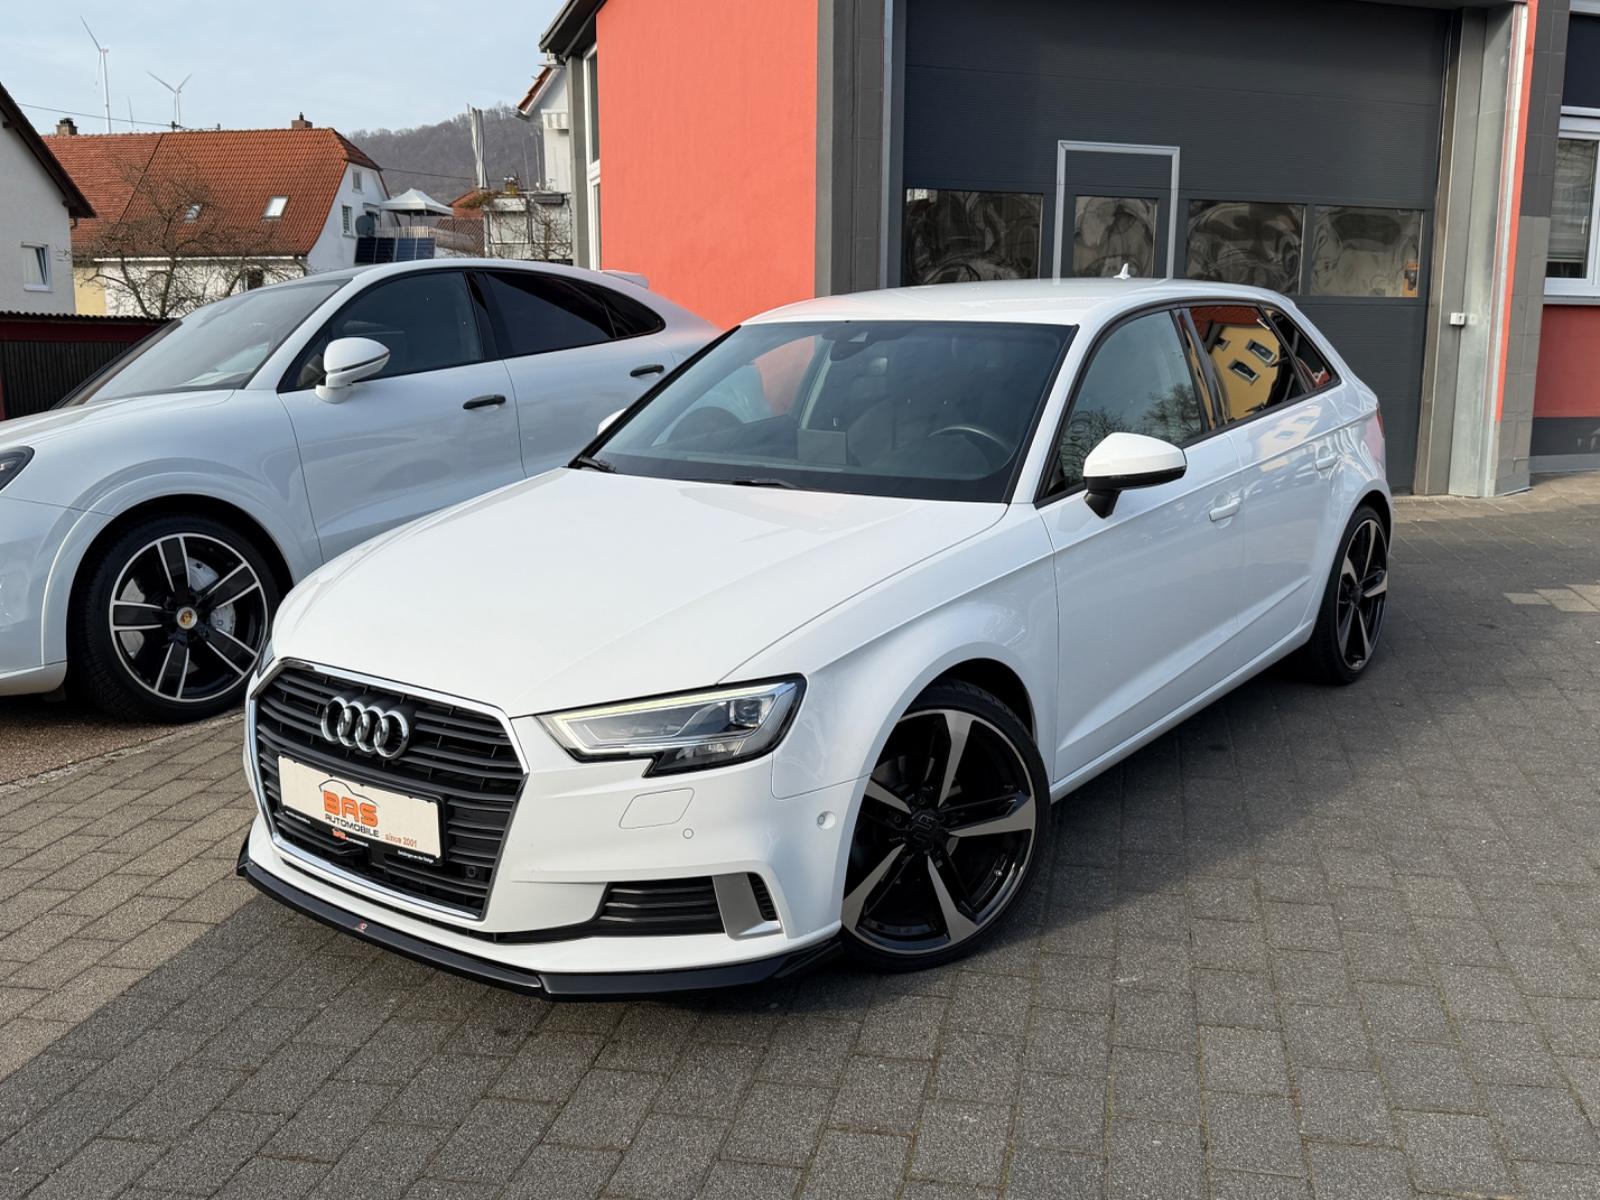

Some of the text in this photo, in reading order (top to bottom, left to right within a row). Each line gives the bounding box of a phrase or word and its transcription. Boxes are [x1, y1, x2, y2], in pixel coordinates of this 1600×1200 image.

[323, 790, 379, 827] BAS
[325, 813, 379, 837] AUTOMOBILE
[385, 832, 417, 848] since 2001
